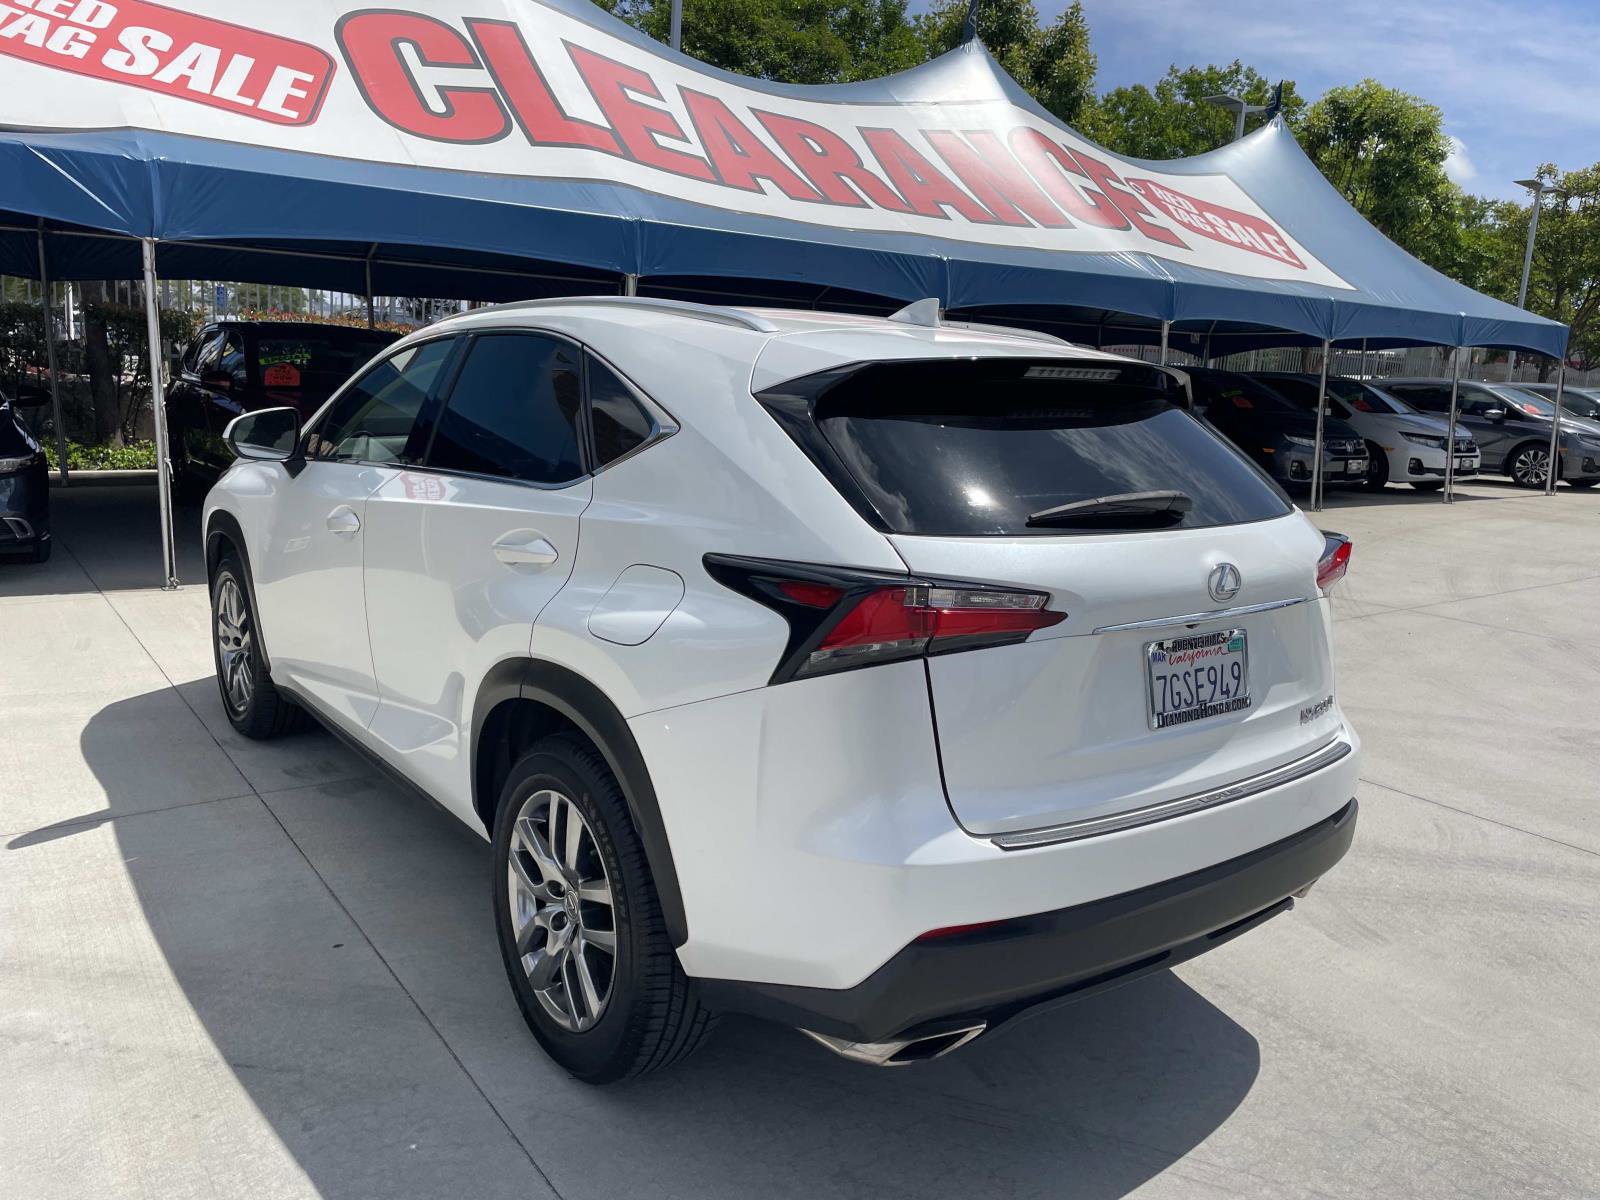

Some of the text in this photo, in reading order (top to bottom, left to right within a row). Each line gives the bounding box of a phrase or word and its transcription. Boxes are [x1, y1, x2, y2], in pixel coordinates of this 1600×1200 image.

[101, 26, 315, 119] SALE
[333, 8, 1193, 252] CLEARANCE
[1147, 182, 1199, 214] RED
[1161, 201, 1216, 234] TAG
[1202, 211, 1301, 265] SALE
[1168, 646, 1229, 667] California
[1156, 661, 1241, 712] 7GSE949
